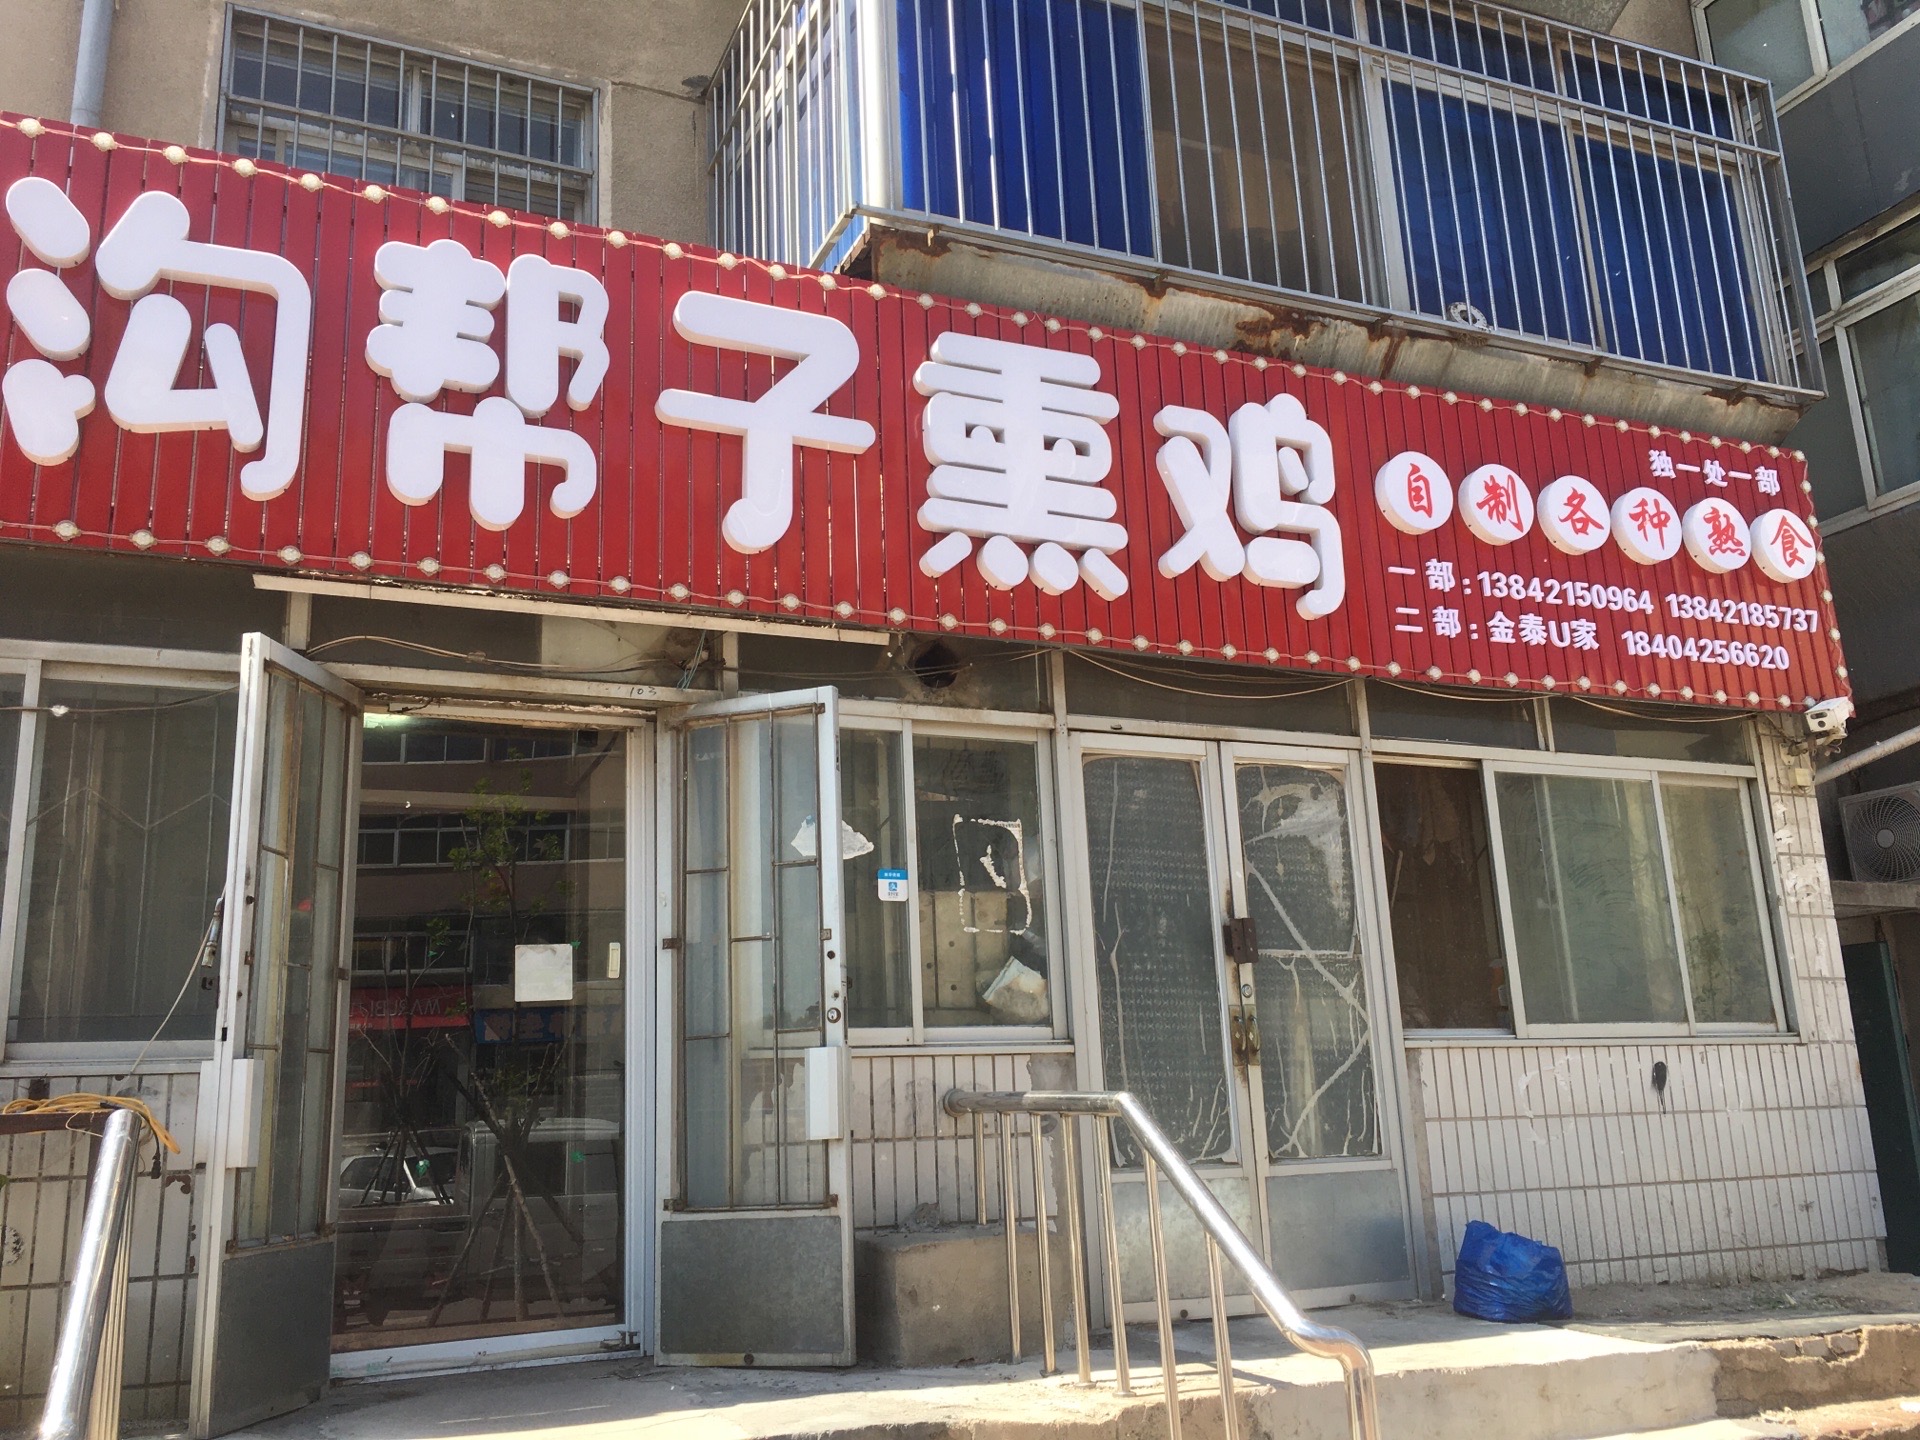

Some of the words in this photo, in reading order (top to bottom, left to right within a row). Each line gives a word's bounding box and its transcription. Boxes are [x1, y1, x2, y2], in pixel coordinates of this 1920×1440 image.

[1648, 449, 1781, 497] 独一处一部
[1405, 462, 1813, 569] 自制各种熟食
[1665, 593, 1819, 633] 13842185737
[1621, 630, 1791, 670] 18404256620
